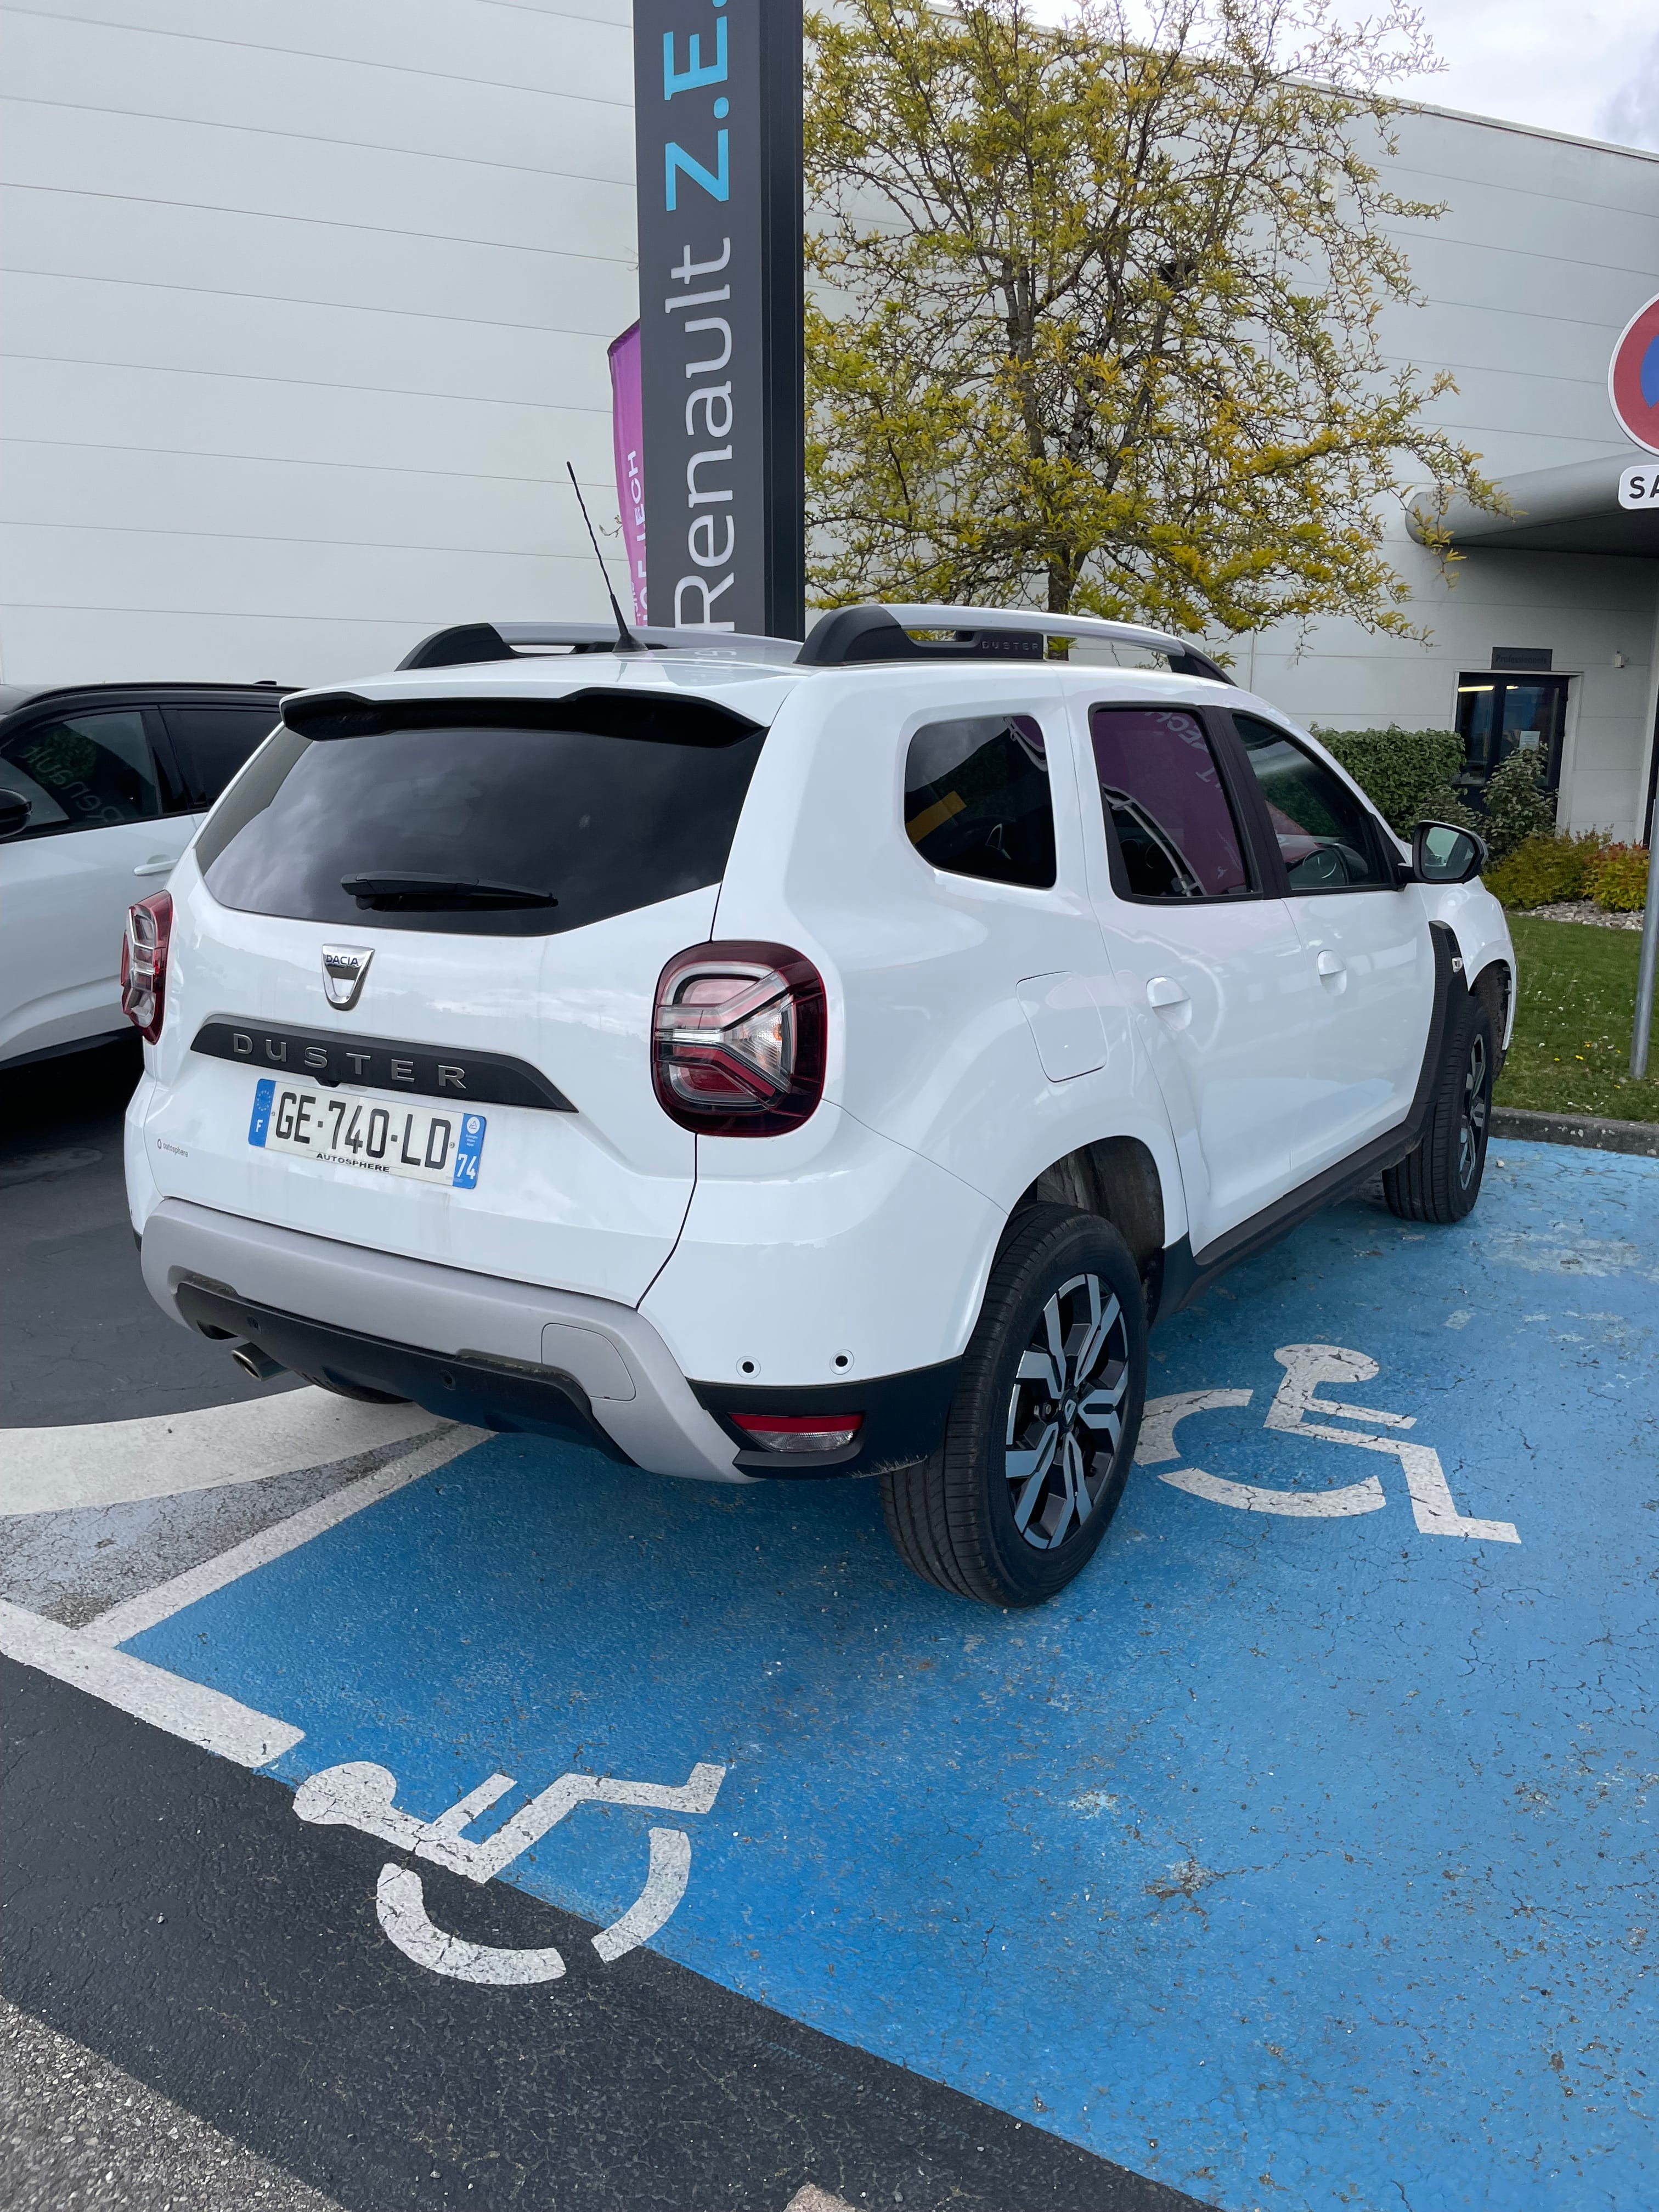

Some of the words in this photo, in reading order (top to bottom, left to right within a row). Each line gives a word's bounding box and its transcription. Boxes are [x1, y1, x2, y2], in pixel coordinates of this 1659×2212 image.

[664, 237, 735, 632] Renault
[981, 641, 1039, 650] DUSTER
[326, 955, 359, 966] DACIA
[233, 1033, 466, 1089] DUSTER
[256, 1119, 263, 1132] F
[163, 1143, 188, 1158] autosphere
[316, 1153, 390, 1173] AUTOSPHERE
[458, 1153, 477, 1180] 74
